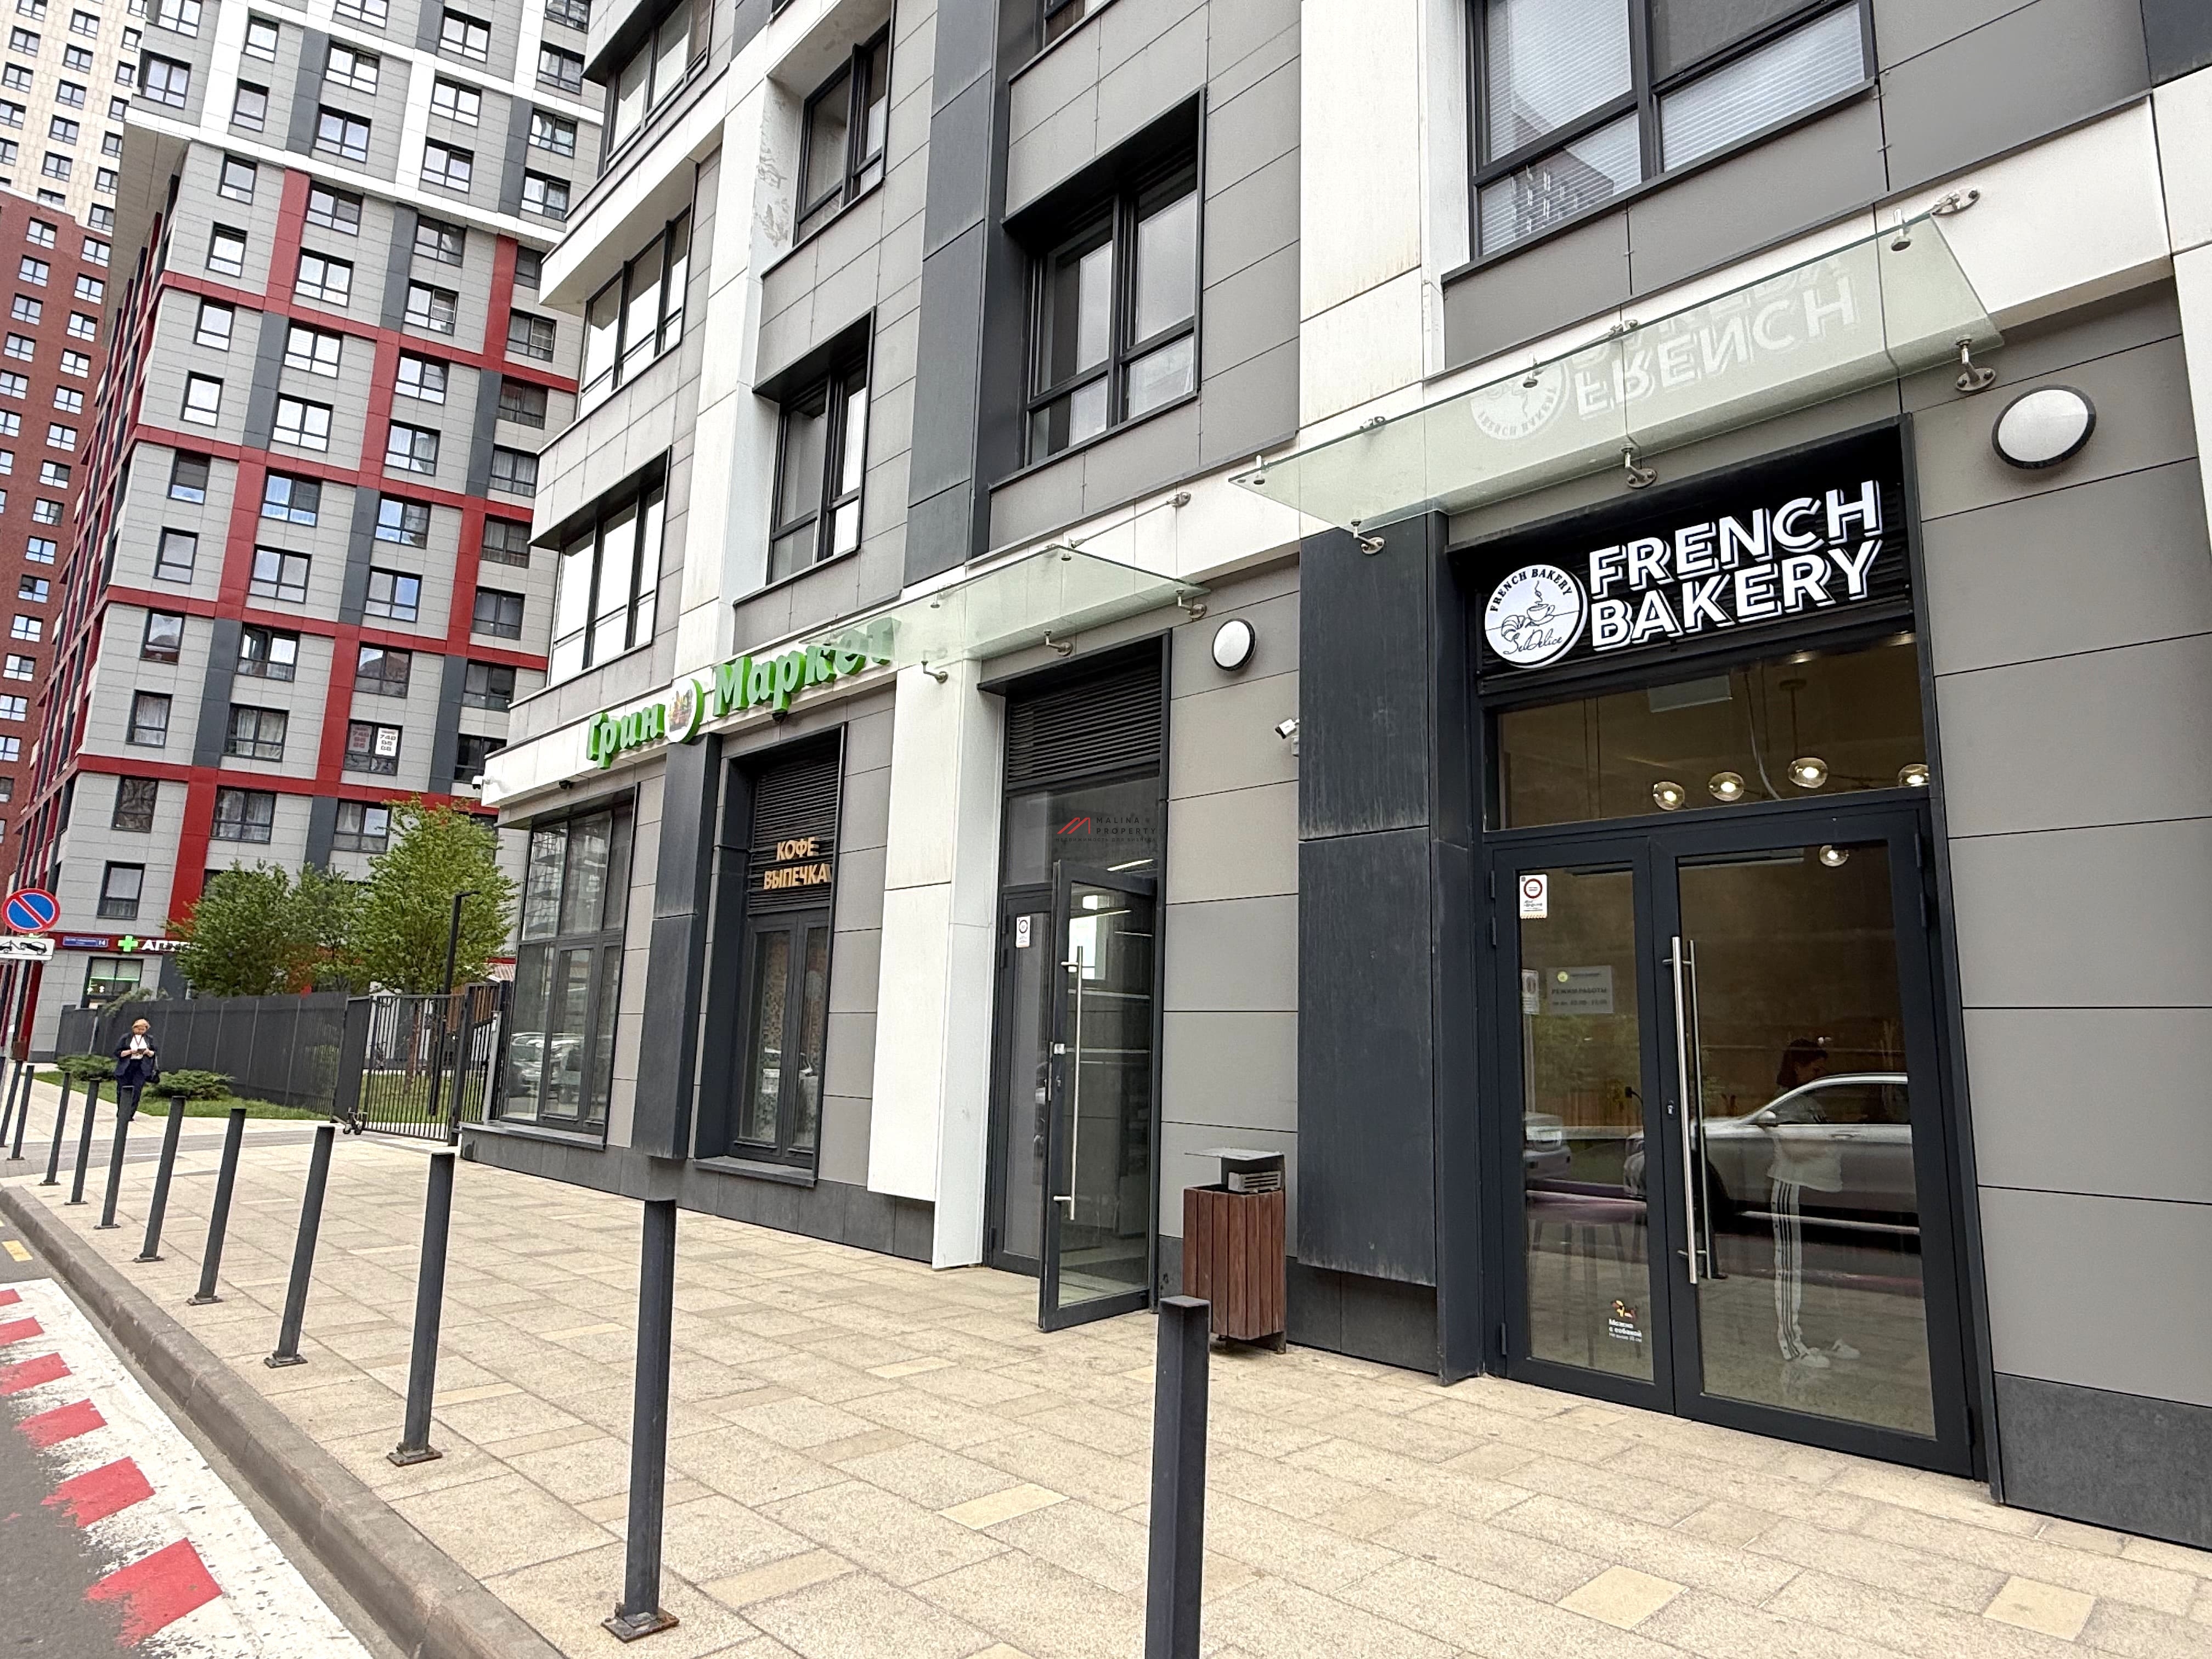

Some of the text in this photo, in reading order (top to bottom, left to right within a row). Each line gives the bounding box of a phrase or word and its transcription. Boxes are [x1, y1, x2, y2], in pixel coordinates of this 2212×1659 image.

[1590, 480, 1882, 599] FRENCH
[1490, 568, 1573, 612] FRENCH BAKERY
[1591, 539, 1883, 652] BAKERY
[586, 617, 901, 769] Грин Маркет
[764, 863, 831, 889] ВЫПЕЧКА
[776, 837, 820, 861] КОФЕ
